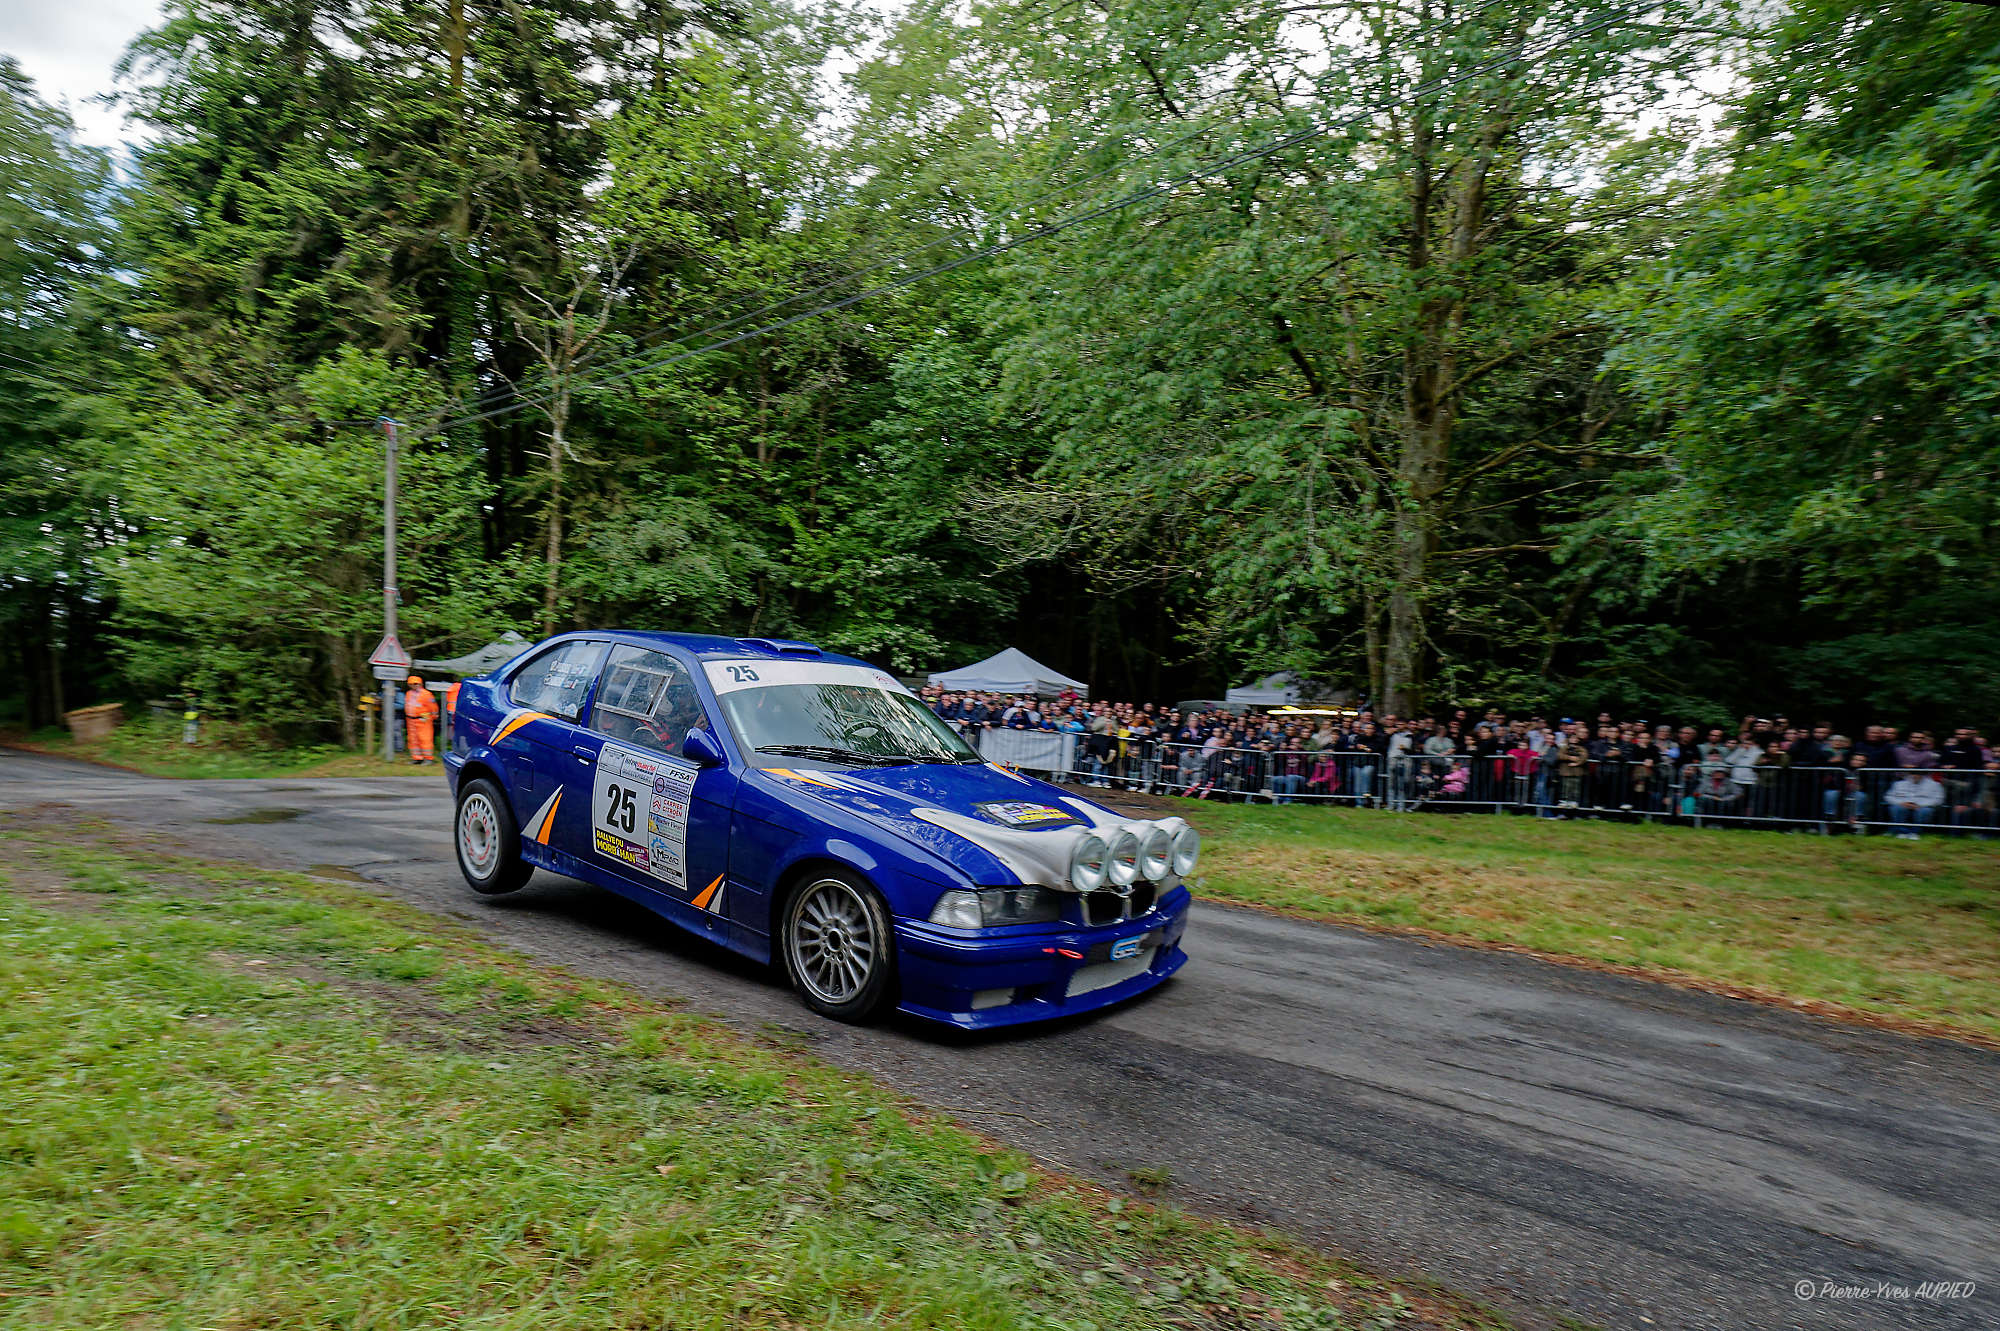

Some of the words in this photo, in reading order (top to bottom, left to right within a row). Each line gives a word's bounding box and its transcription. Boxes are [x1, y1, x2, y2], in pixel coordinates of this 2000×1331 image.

[726, 665, 760, 682] 25
[669, 769, 690, 781] FFSA
[607, 784, 637, 833] 25
[597, 830, 616, 844] RALLYE
